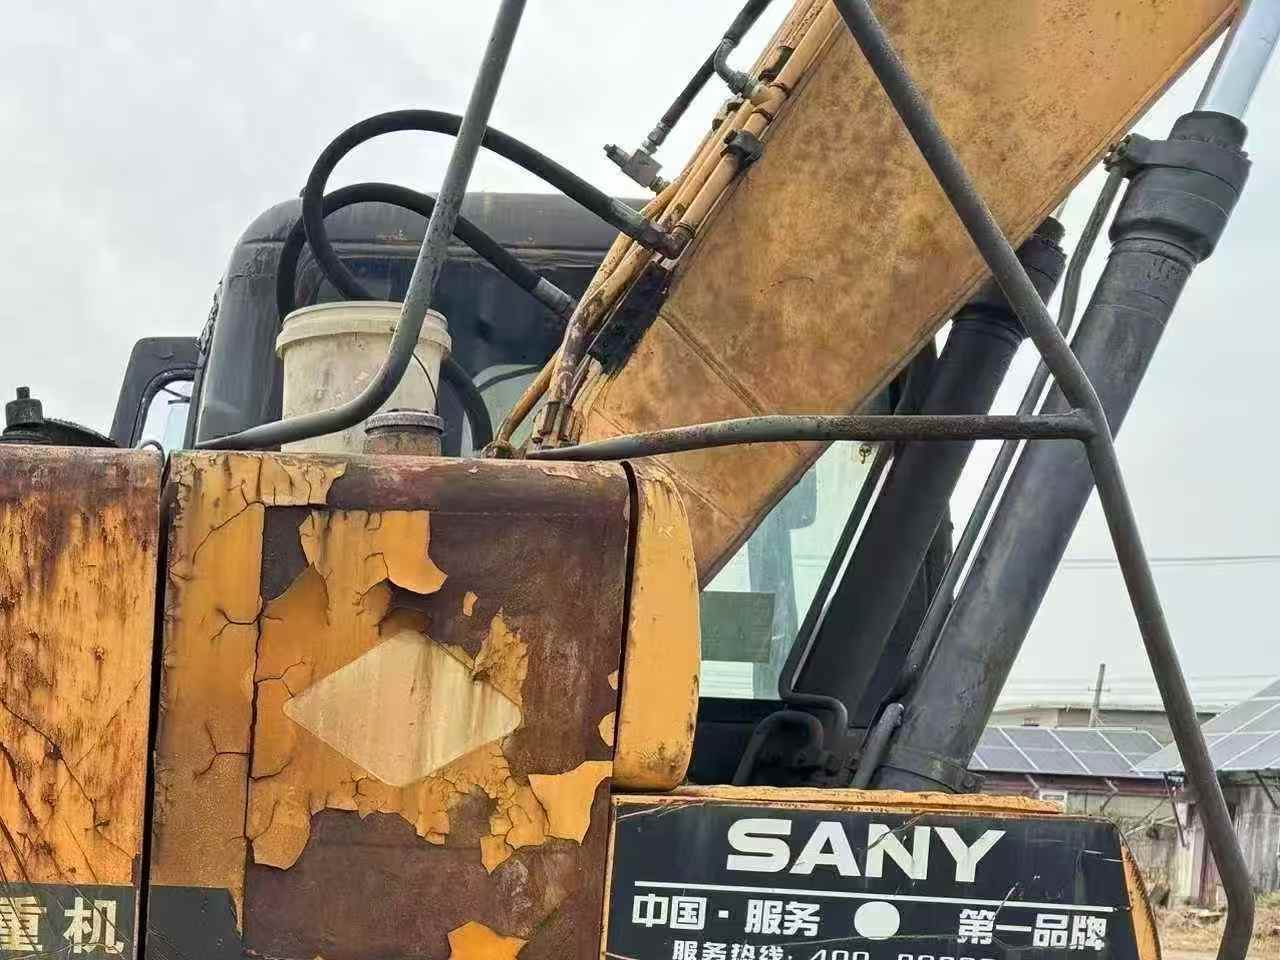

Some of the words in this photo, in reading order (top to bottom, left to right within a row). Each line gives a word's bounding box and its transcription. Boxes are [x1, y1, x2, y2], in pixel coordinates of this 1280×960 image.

[725, 817, 1007, 883] SANY
[956, 908, 1108, 951] 第一品牌
